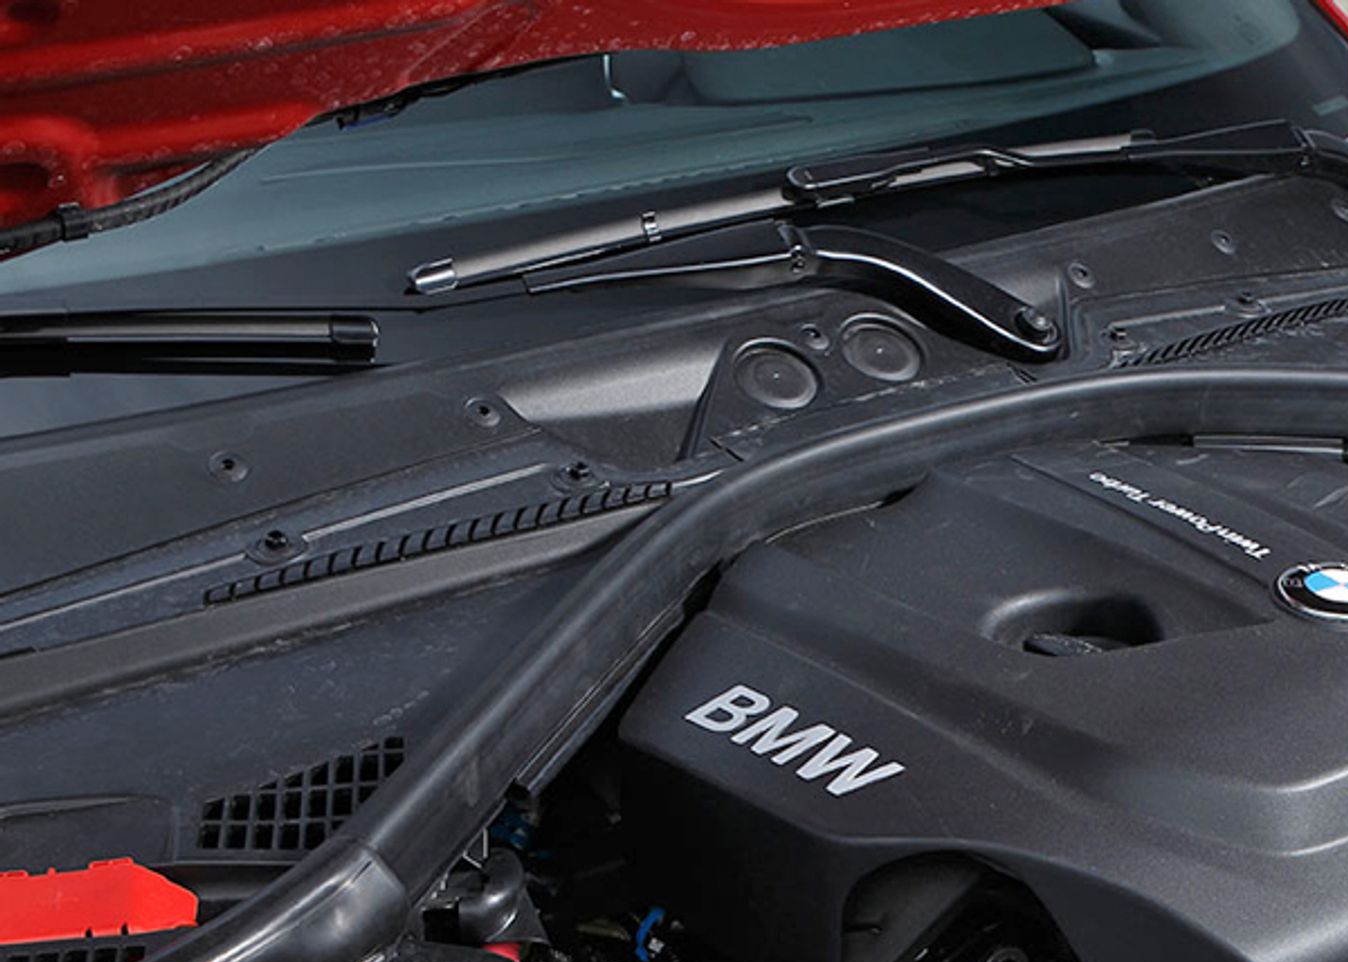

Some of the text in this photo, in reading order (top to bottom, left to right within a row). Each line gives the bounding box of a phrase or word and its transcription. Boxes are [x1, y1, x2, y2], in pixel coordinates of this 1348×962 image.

[1089, 472, 1272, 560] TwinPower Turbo
[684, 685, 906, 796] BMW
